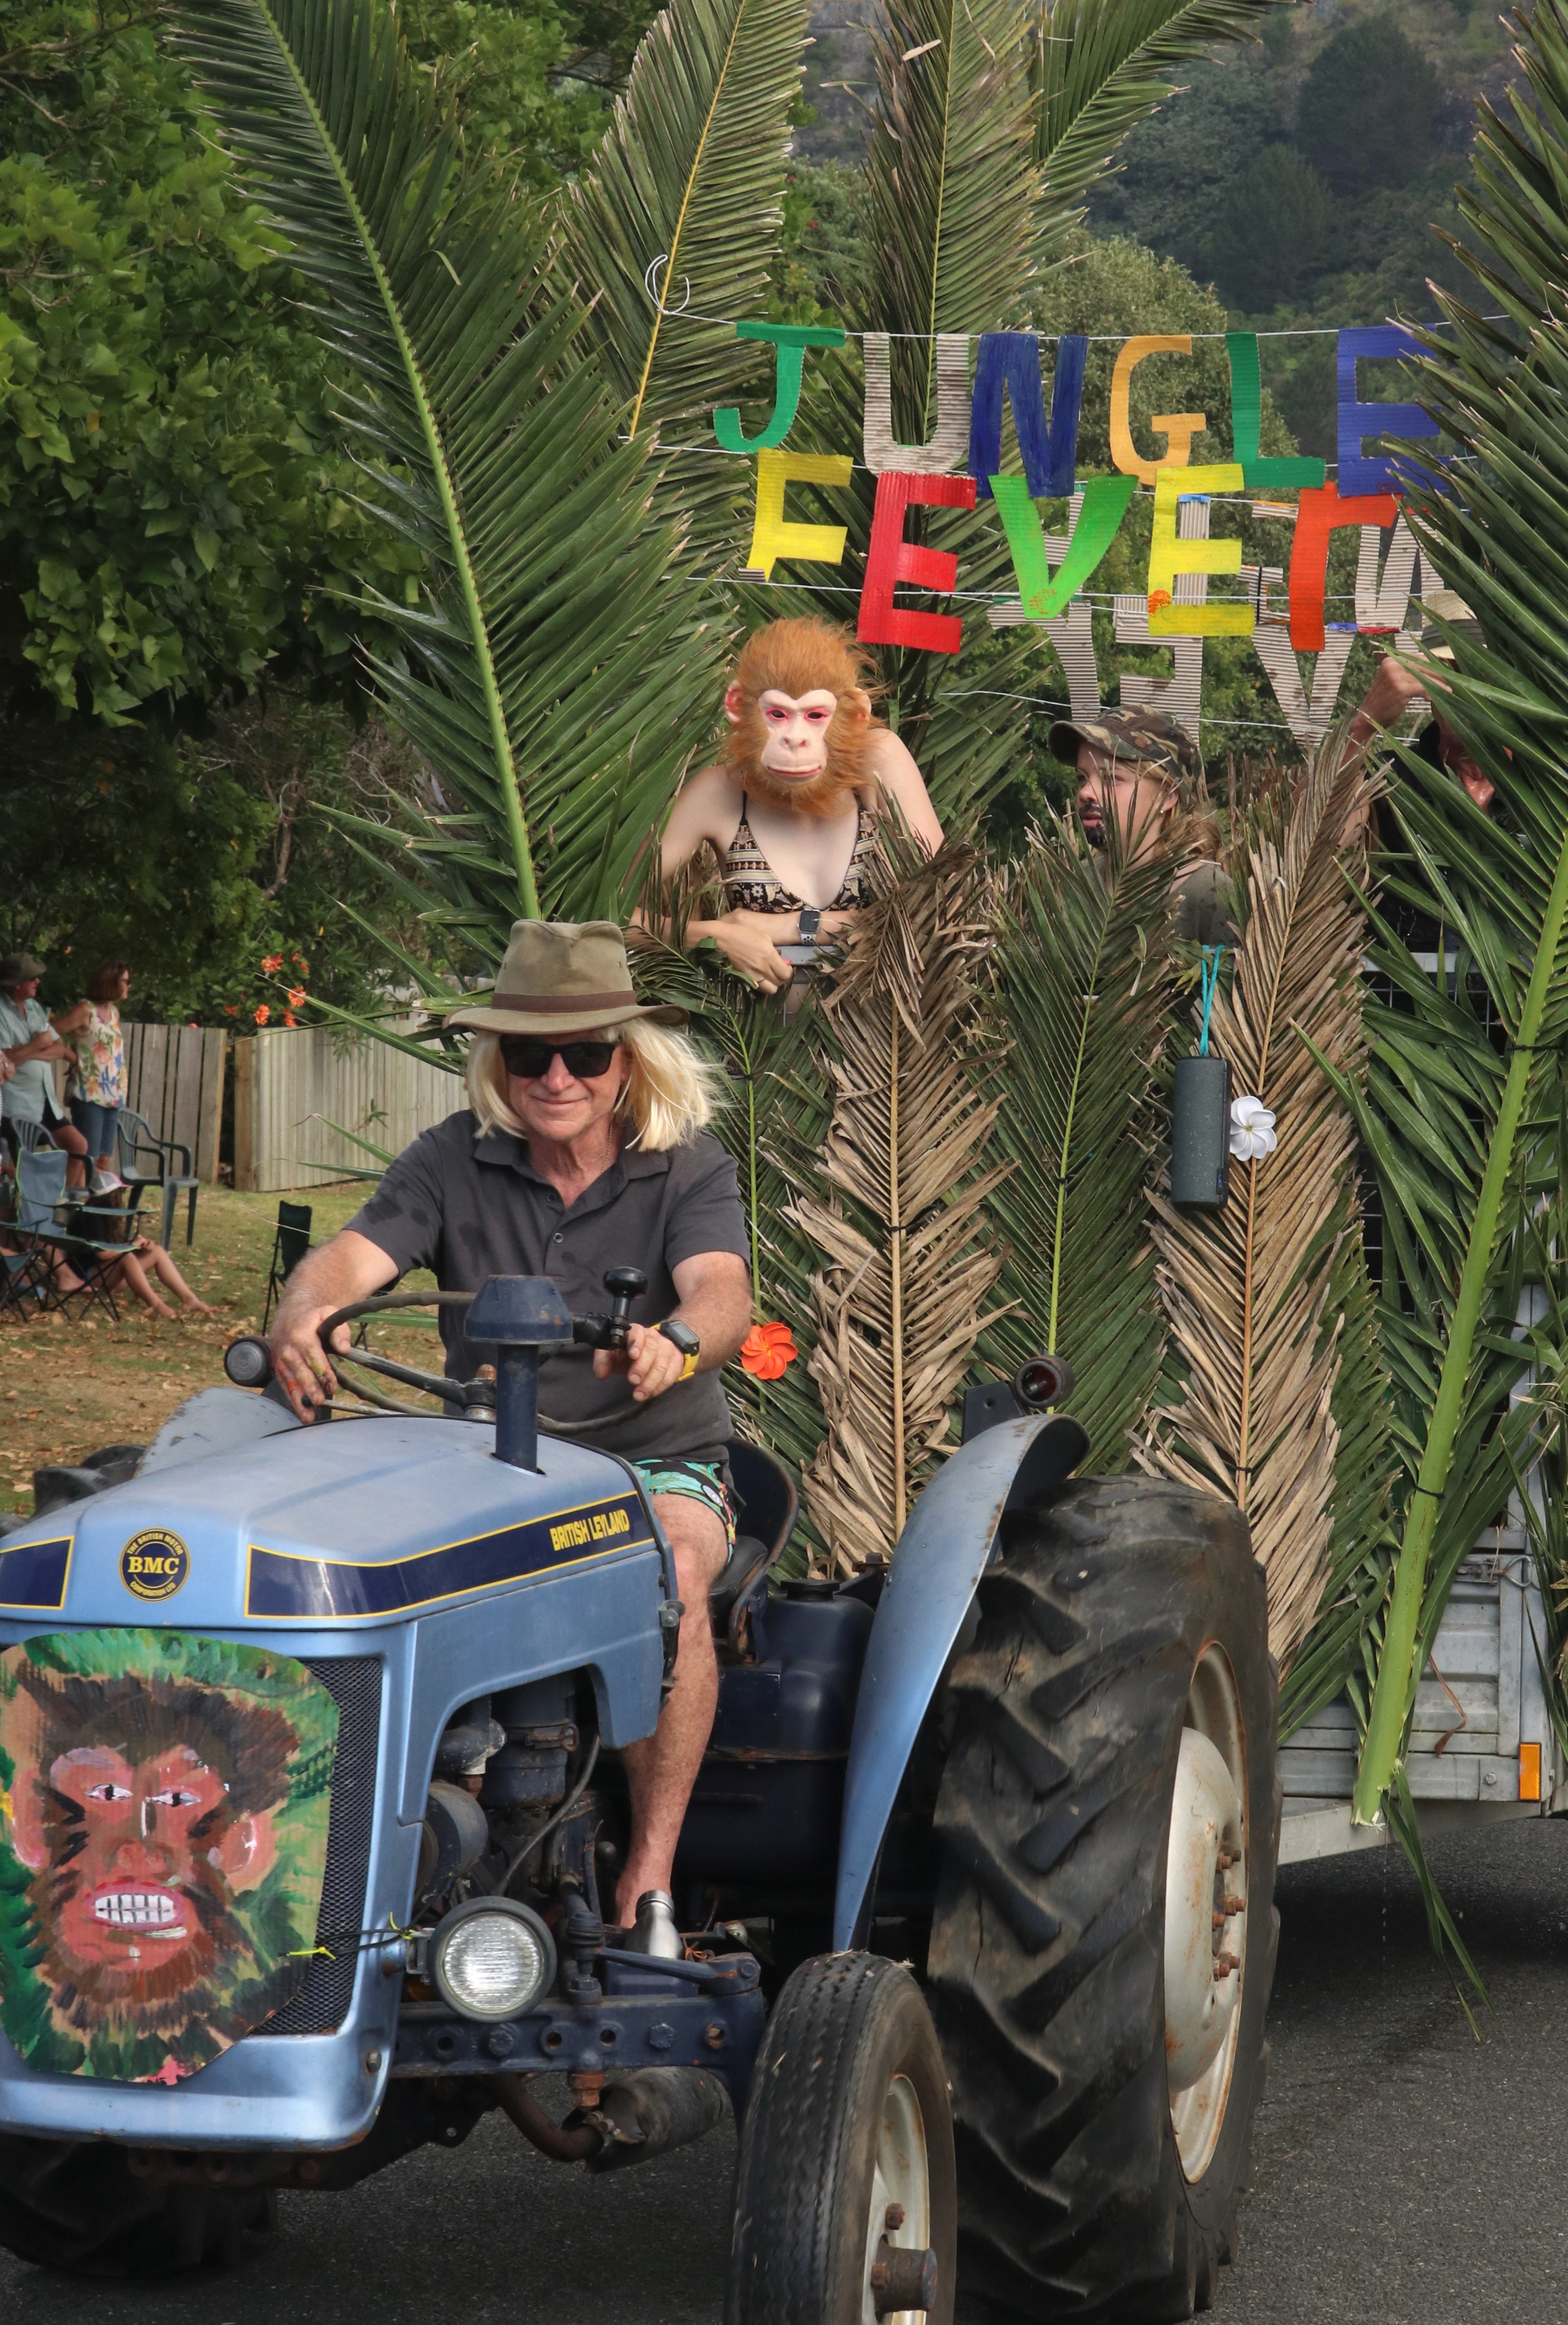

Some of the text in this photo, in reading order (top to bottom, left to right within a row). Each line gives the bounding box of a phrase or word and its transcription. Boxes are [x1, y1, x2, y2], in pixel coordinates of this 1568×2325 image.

[714, 321, 1450, 498] JUNGLE
[126, 1533, 184, 1556] THE BRITISH MOTOR
[550, 1509, 630, 1551] BRITISH LEYLAND
[127, 1556, 179, 1575] BMC
